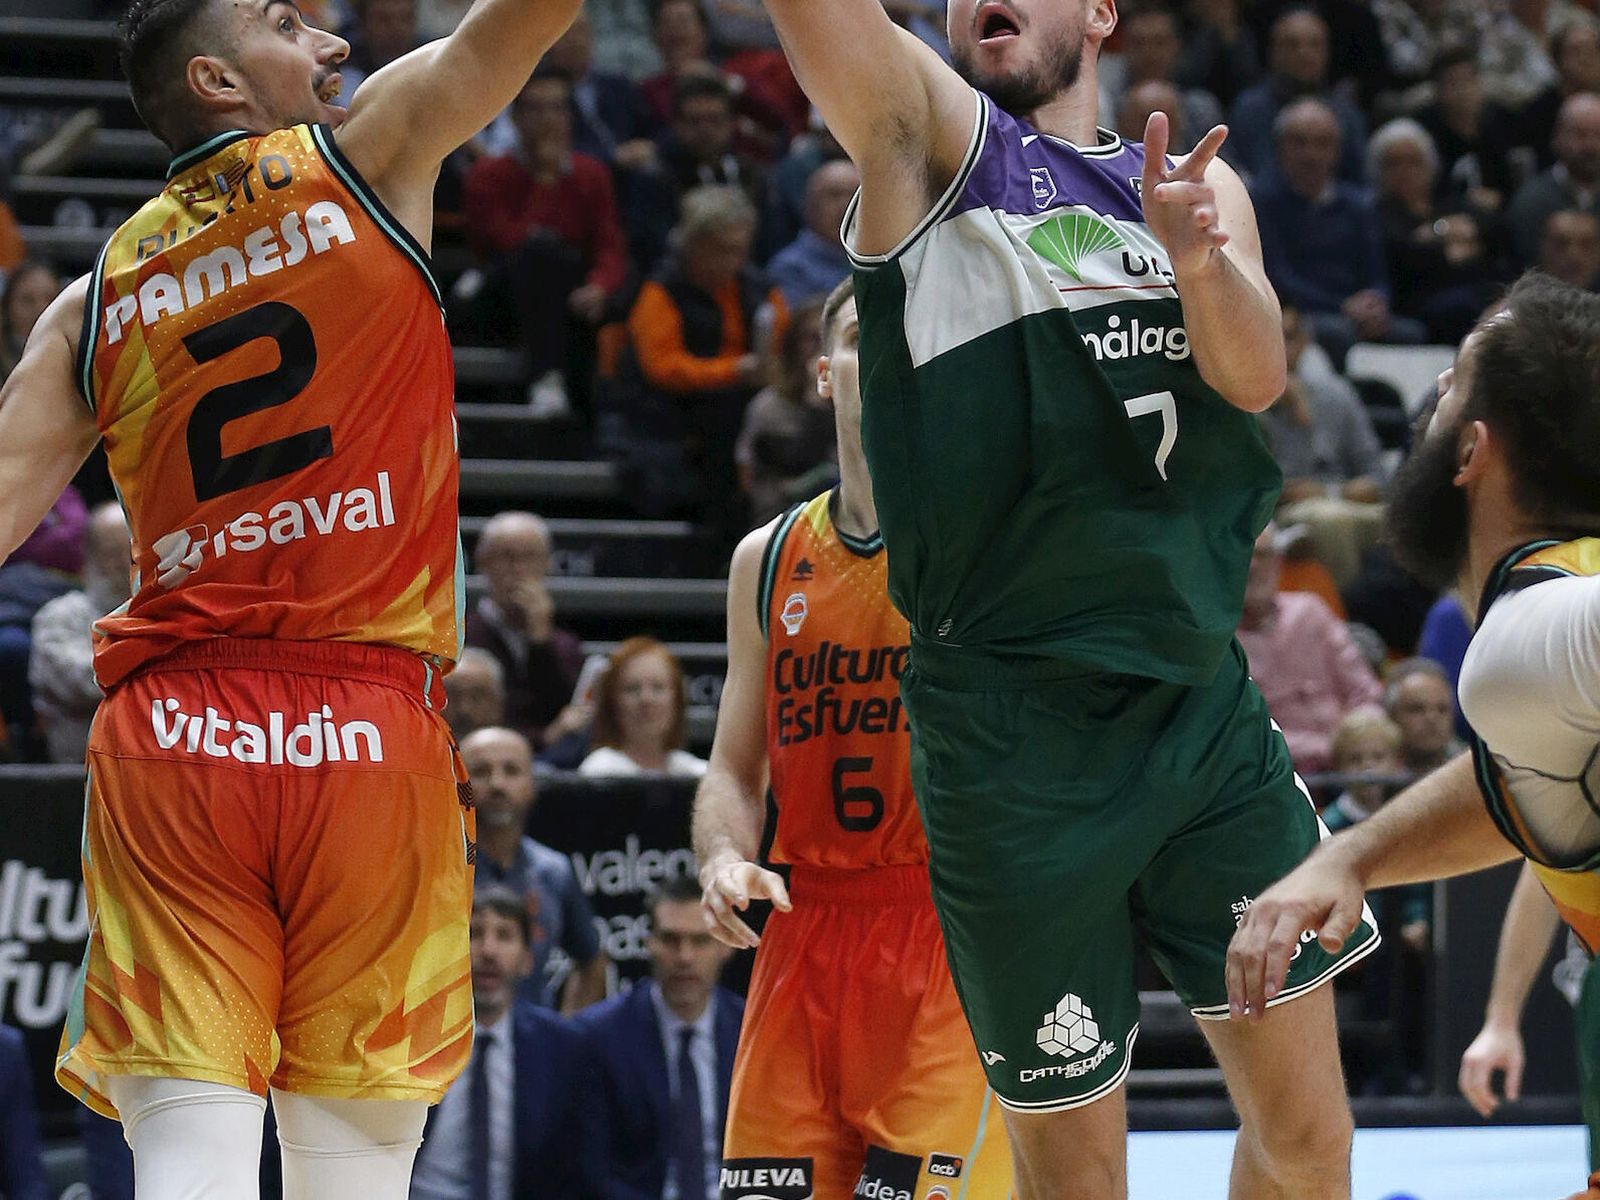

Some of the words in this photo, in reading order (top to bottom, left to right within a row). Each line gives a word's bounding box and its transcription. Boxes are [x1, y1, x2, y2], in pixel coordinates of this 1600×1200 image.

[105, 201, 356, 345] PAMESA
[181, 301, 334, 502] 2
[1124, 391, 1178, 482] 7
[777, 687, 911, 746] Esfuer
[832, 757, 884, 832] 6
[0, 940, 78, 1028] fu
